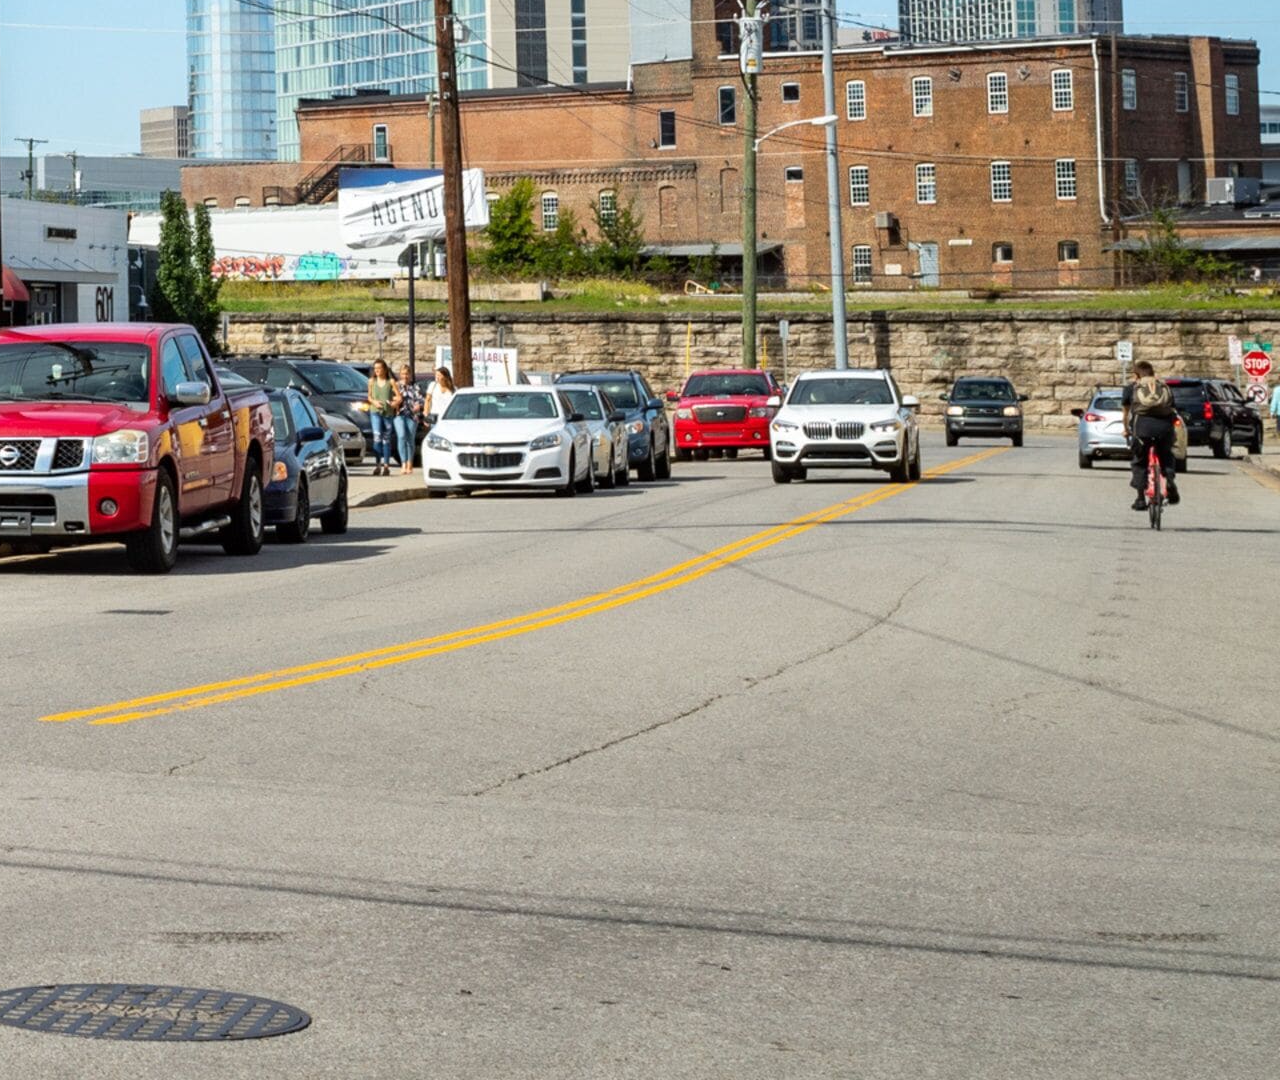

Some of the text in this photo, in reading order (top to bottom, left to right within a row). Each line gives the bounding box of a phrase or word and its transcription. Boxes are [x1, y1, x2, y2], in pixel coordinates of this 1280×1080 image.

[372, 188, 443, 226] AGEND
[95, 286, 114, 322] 601
[1244, 358, 1269, 370] STOP
